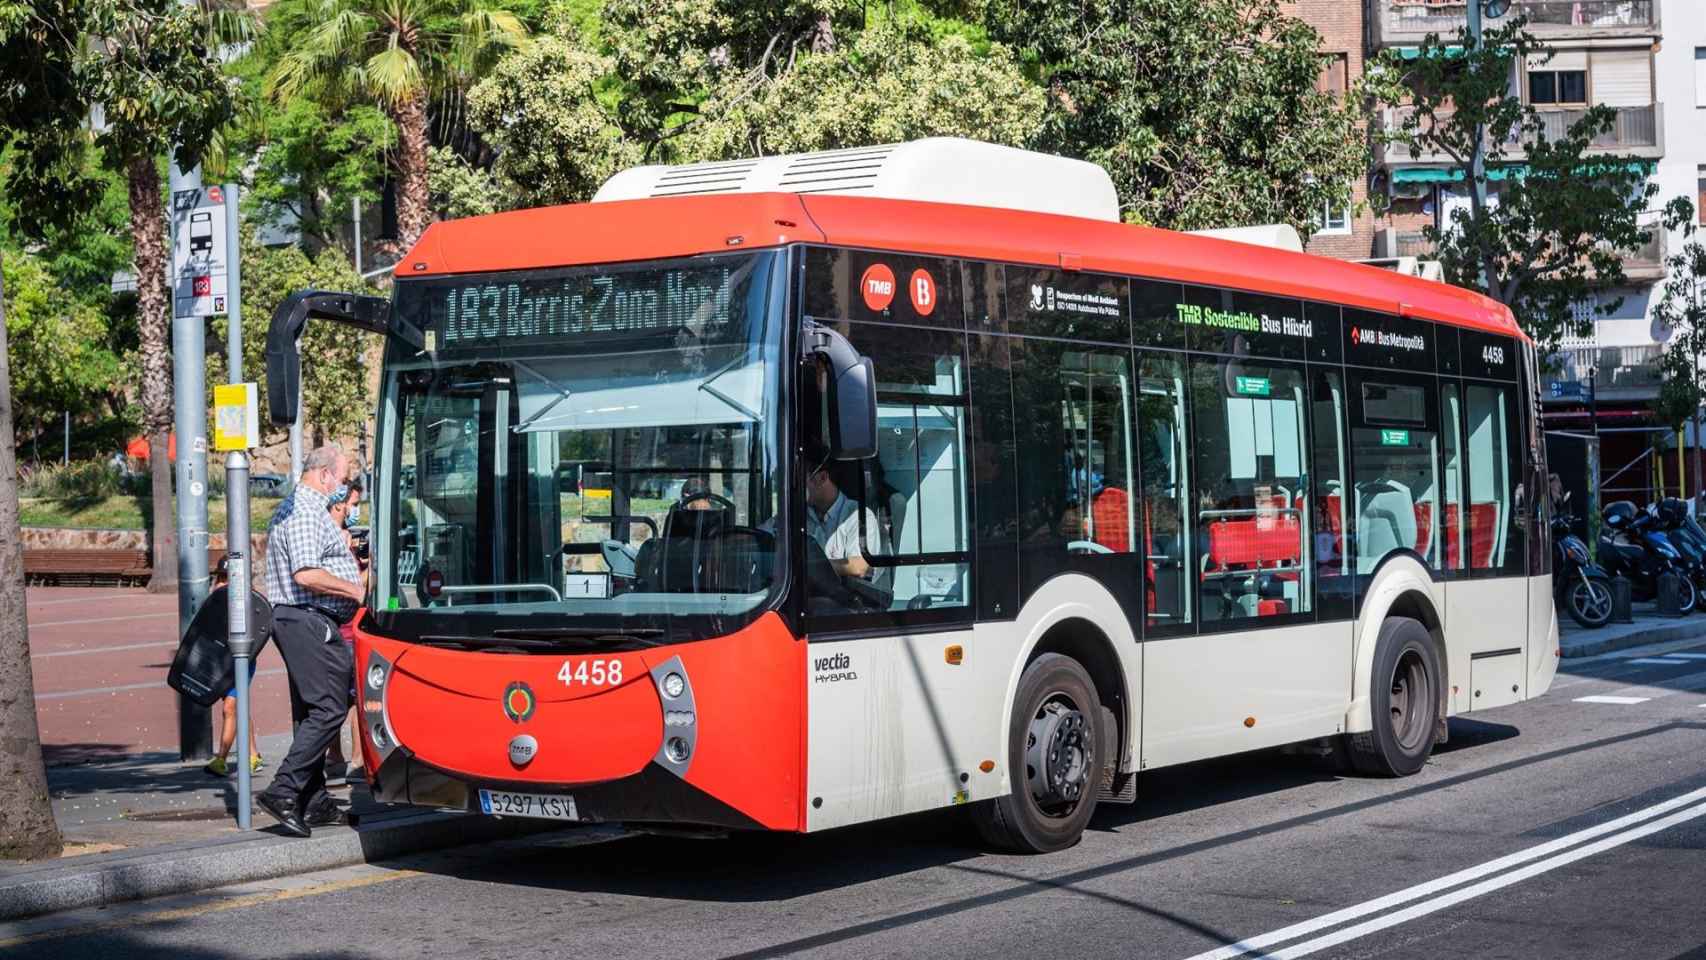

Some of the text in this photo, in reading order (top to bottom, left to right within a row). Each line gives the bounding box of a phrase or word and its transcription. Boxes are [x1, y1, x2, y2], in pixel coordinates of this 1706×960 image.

[868, 280, 892, 296] TMB
[916, 278, 931, 305] B
[445, 269, 729, 341] 183 Barris Zona Nord
[1176, 303, 1202, 324] TMB
[1204, 306, 1259, 331] Sostenible
[1261, 314, 1281, 334] Bus
[1360, 329, 1375, 344] AMB
[1482, 346, 1504, 364] 4458
[584, 579, 590, 593] 1
[814, 653, 850, 671] vectia
[557, 659, 623, 686] 4458
[815, 671, 858, 683] HYBRID
[491, 794, 570, 817] 5297 KSV
